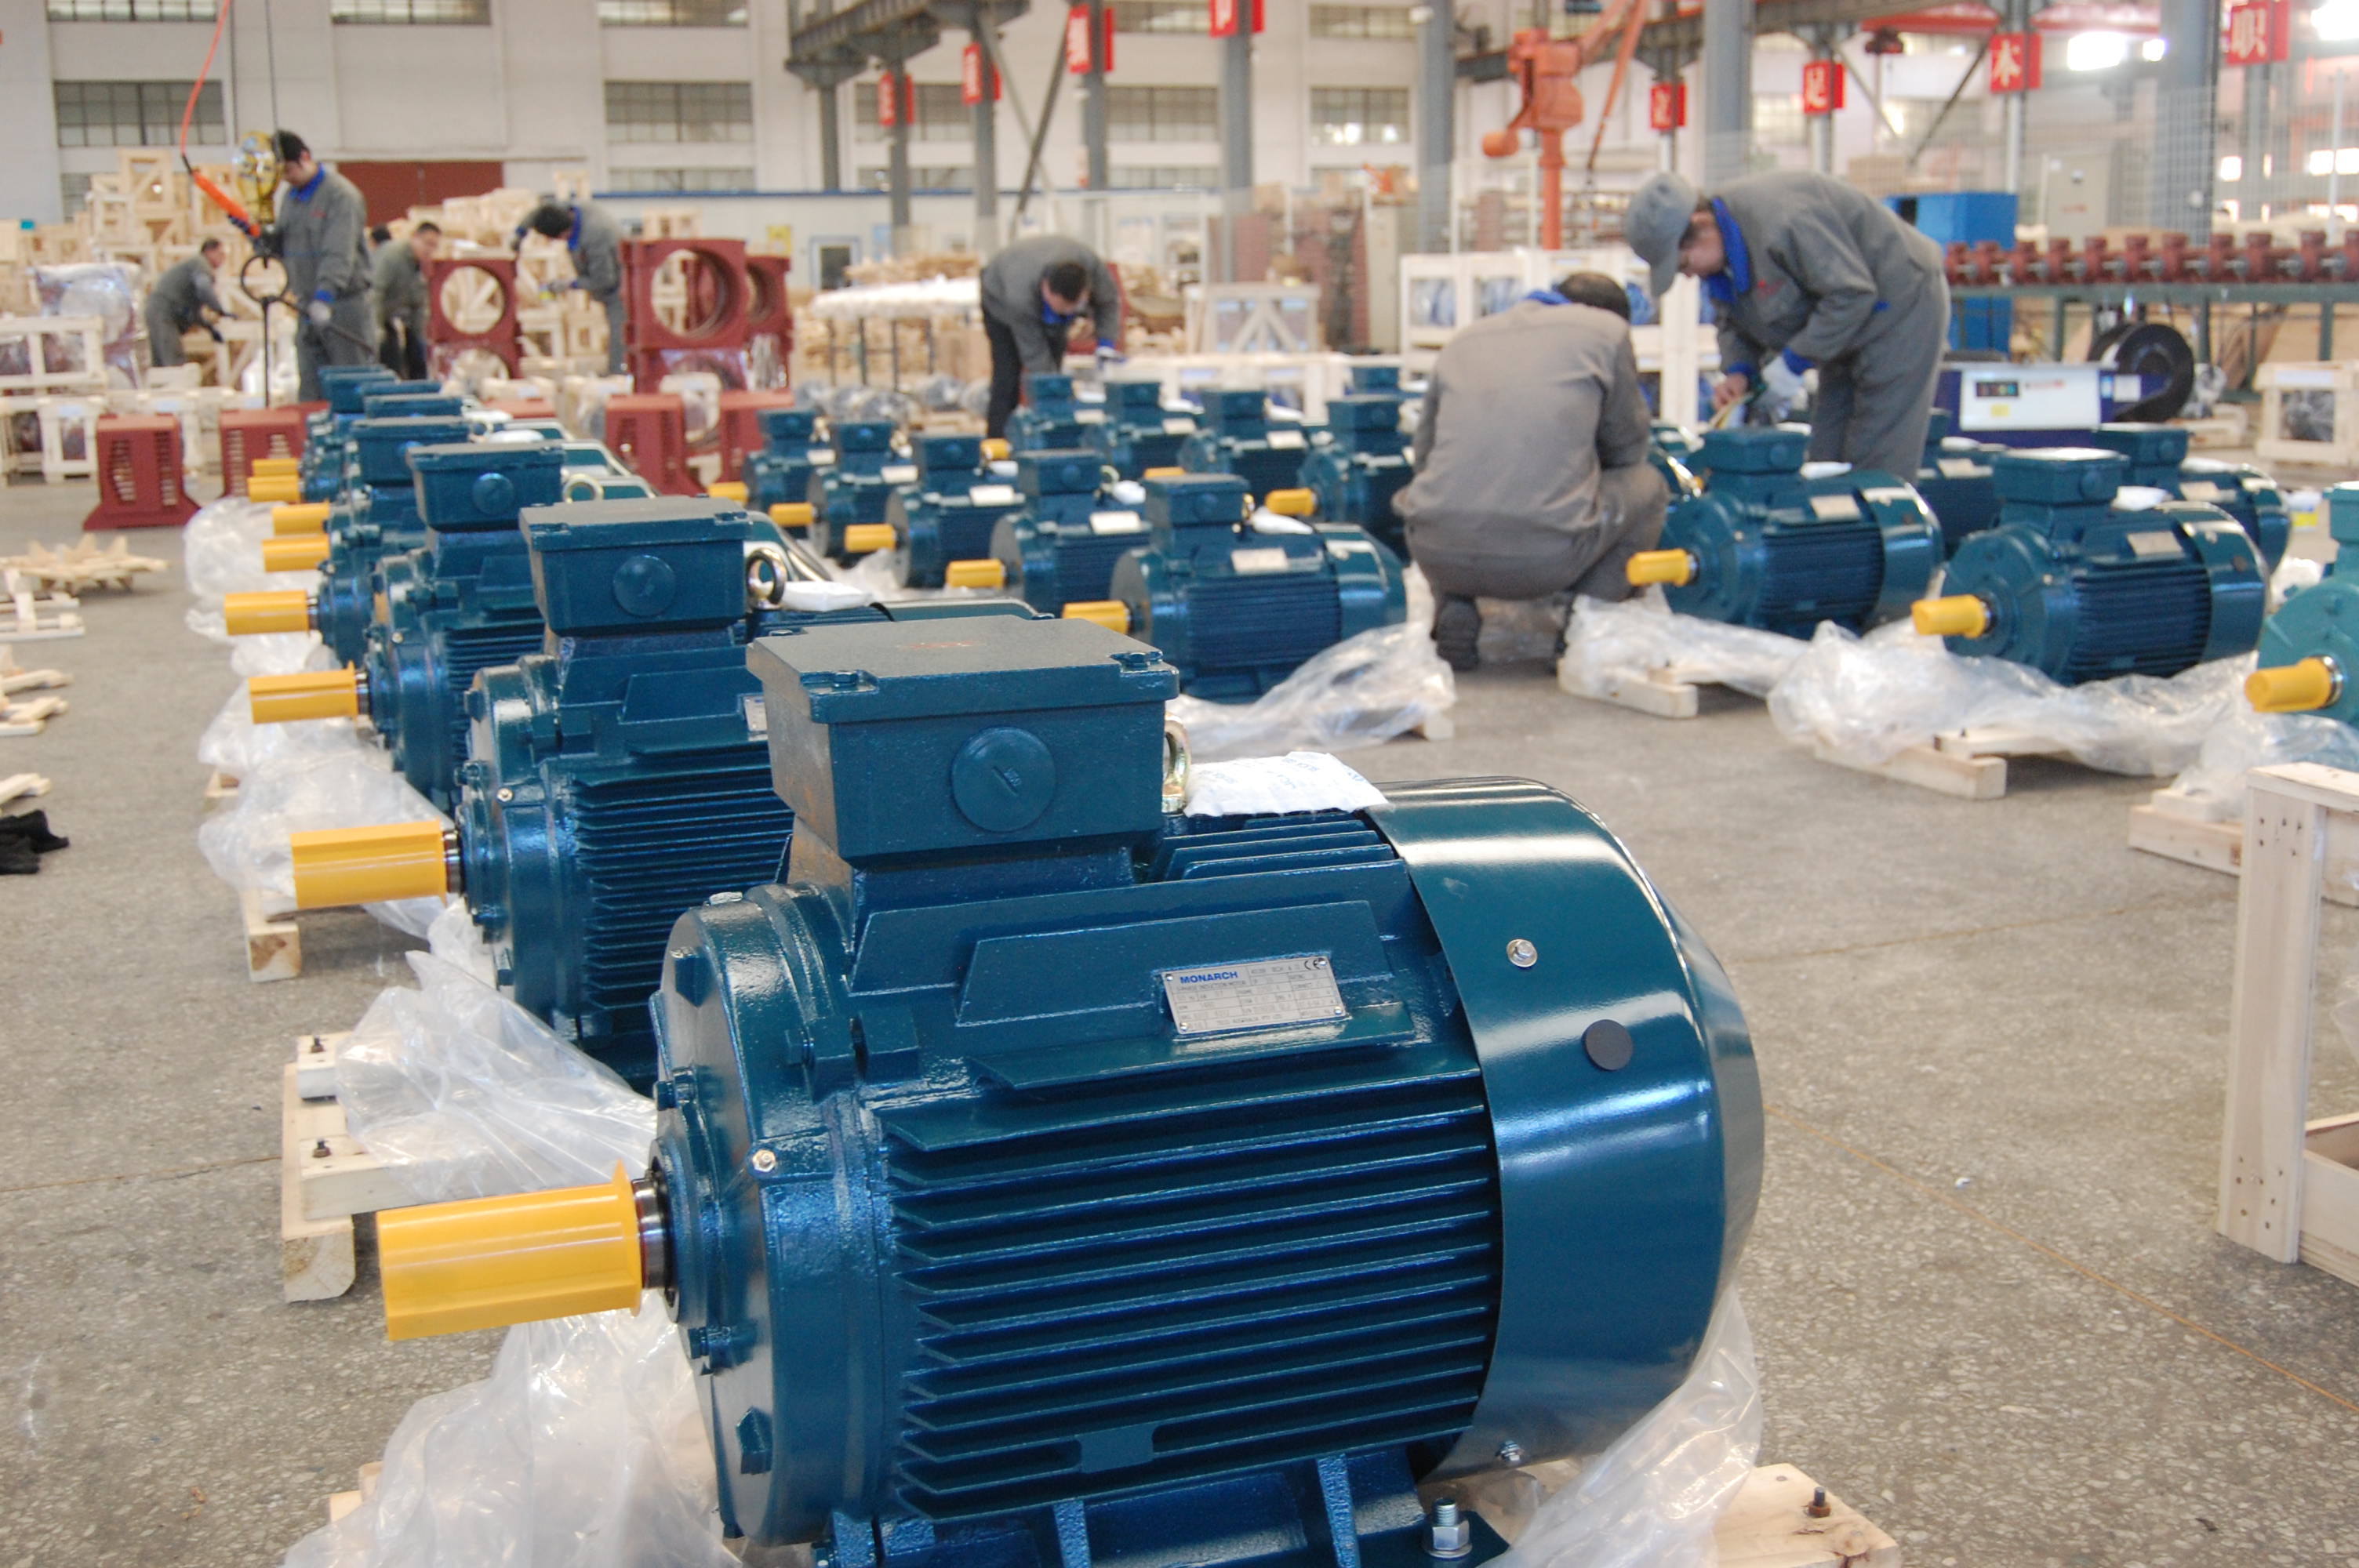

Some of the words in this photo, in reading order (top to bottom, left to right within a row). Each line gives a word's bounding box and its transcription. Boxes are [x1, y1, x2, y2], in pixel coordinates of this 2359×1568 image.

[2233, 8, 2265, 59] 职
[1992, 40, 2021, 88] 本
[1180, 971, 1238, 984] MONARCH
